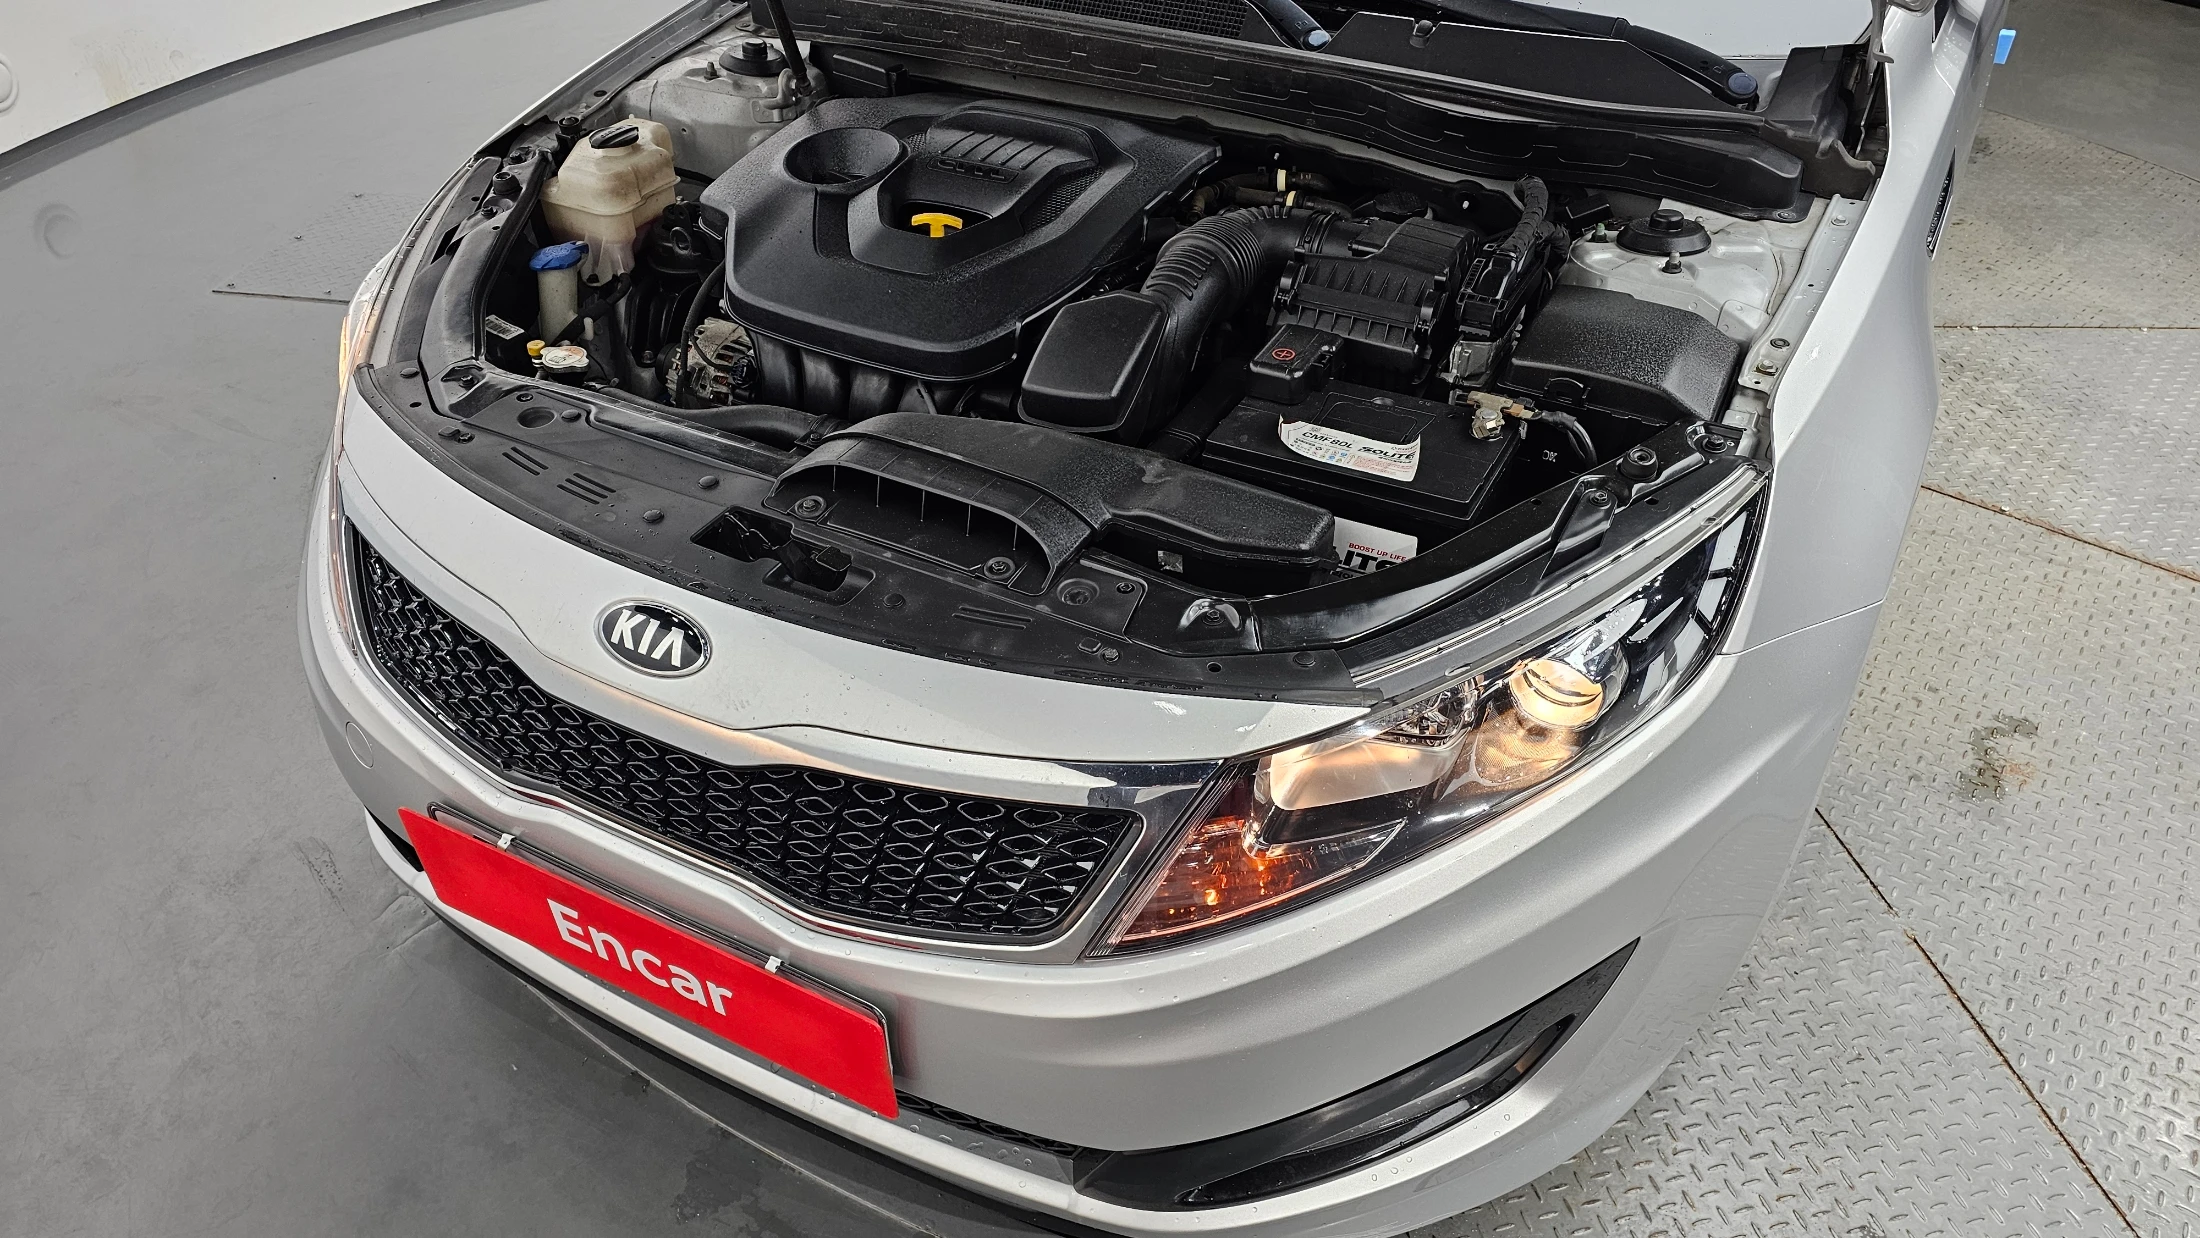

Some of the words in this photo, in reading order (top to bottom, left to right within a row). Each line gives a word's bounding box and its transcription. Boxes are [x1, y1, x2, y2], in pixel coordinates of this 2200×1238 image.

[1348, 542, 1376, 554] BOOST
[1376, 549, 1389, 558] UP
[1389, 553, 1407, 563] LIFE
[610, 608, 685, 668] KIA
[546, 898, 733, 1016] Encar
